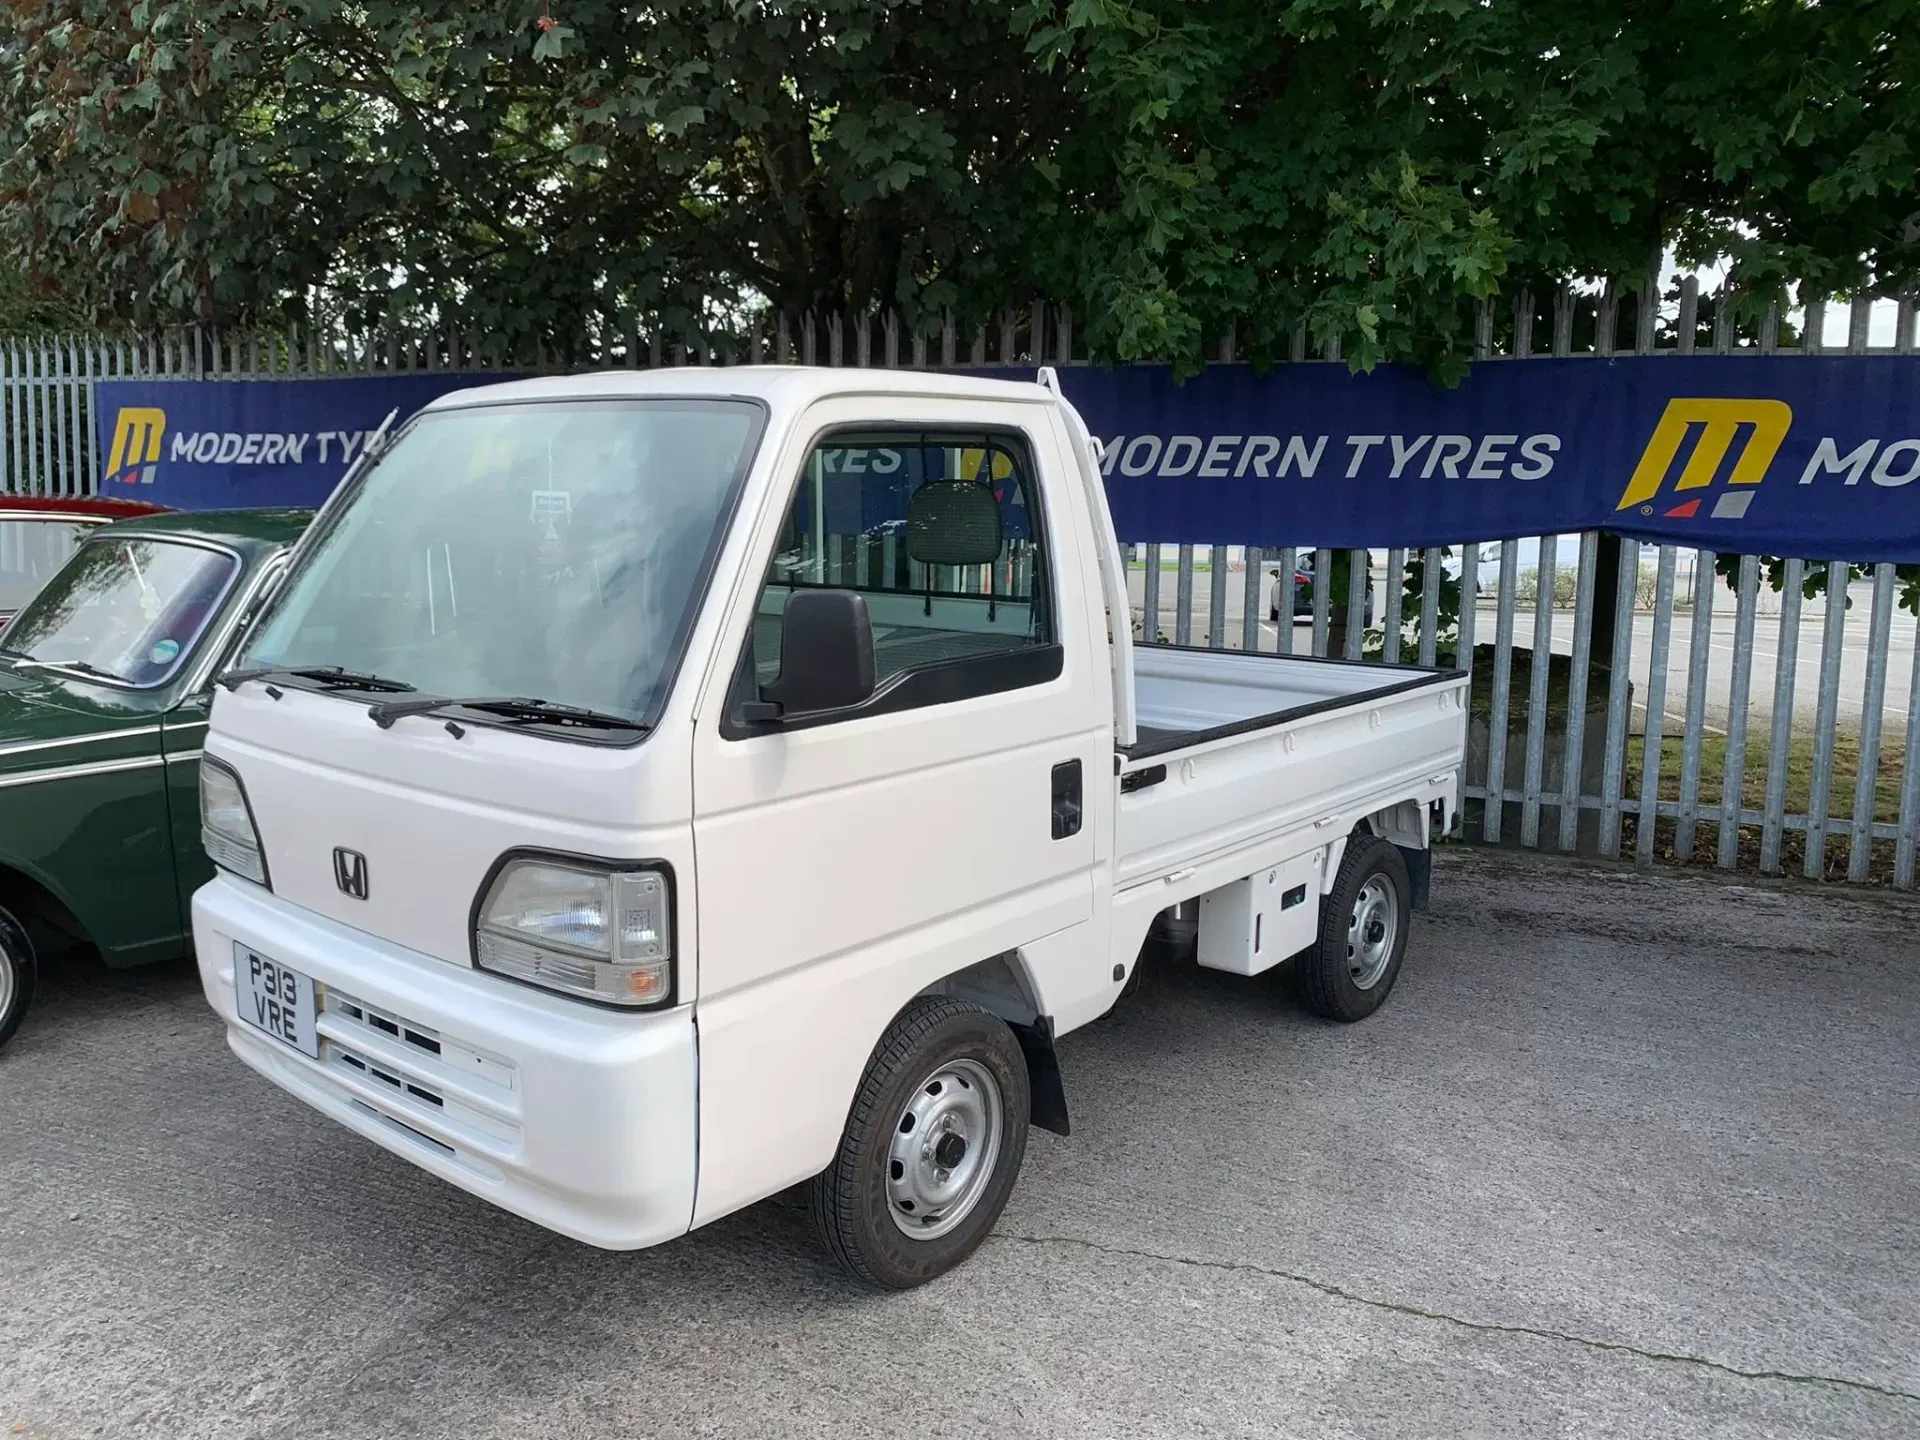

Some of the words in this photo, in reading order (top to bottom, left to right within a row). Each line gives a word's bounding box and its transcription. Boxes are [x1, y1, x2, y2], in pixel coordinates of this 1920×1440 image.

[171, 432, 310, 464] MODERN
[316, 430, 398, 464] TY
[1345, 434, 1561, 480] TYRES
[1798, 437, 1920, 486] MO
[249, 953, 297, 1006] P313
[254, 991, 298, 1043] VRE
